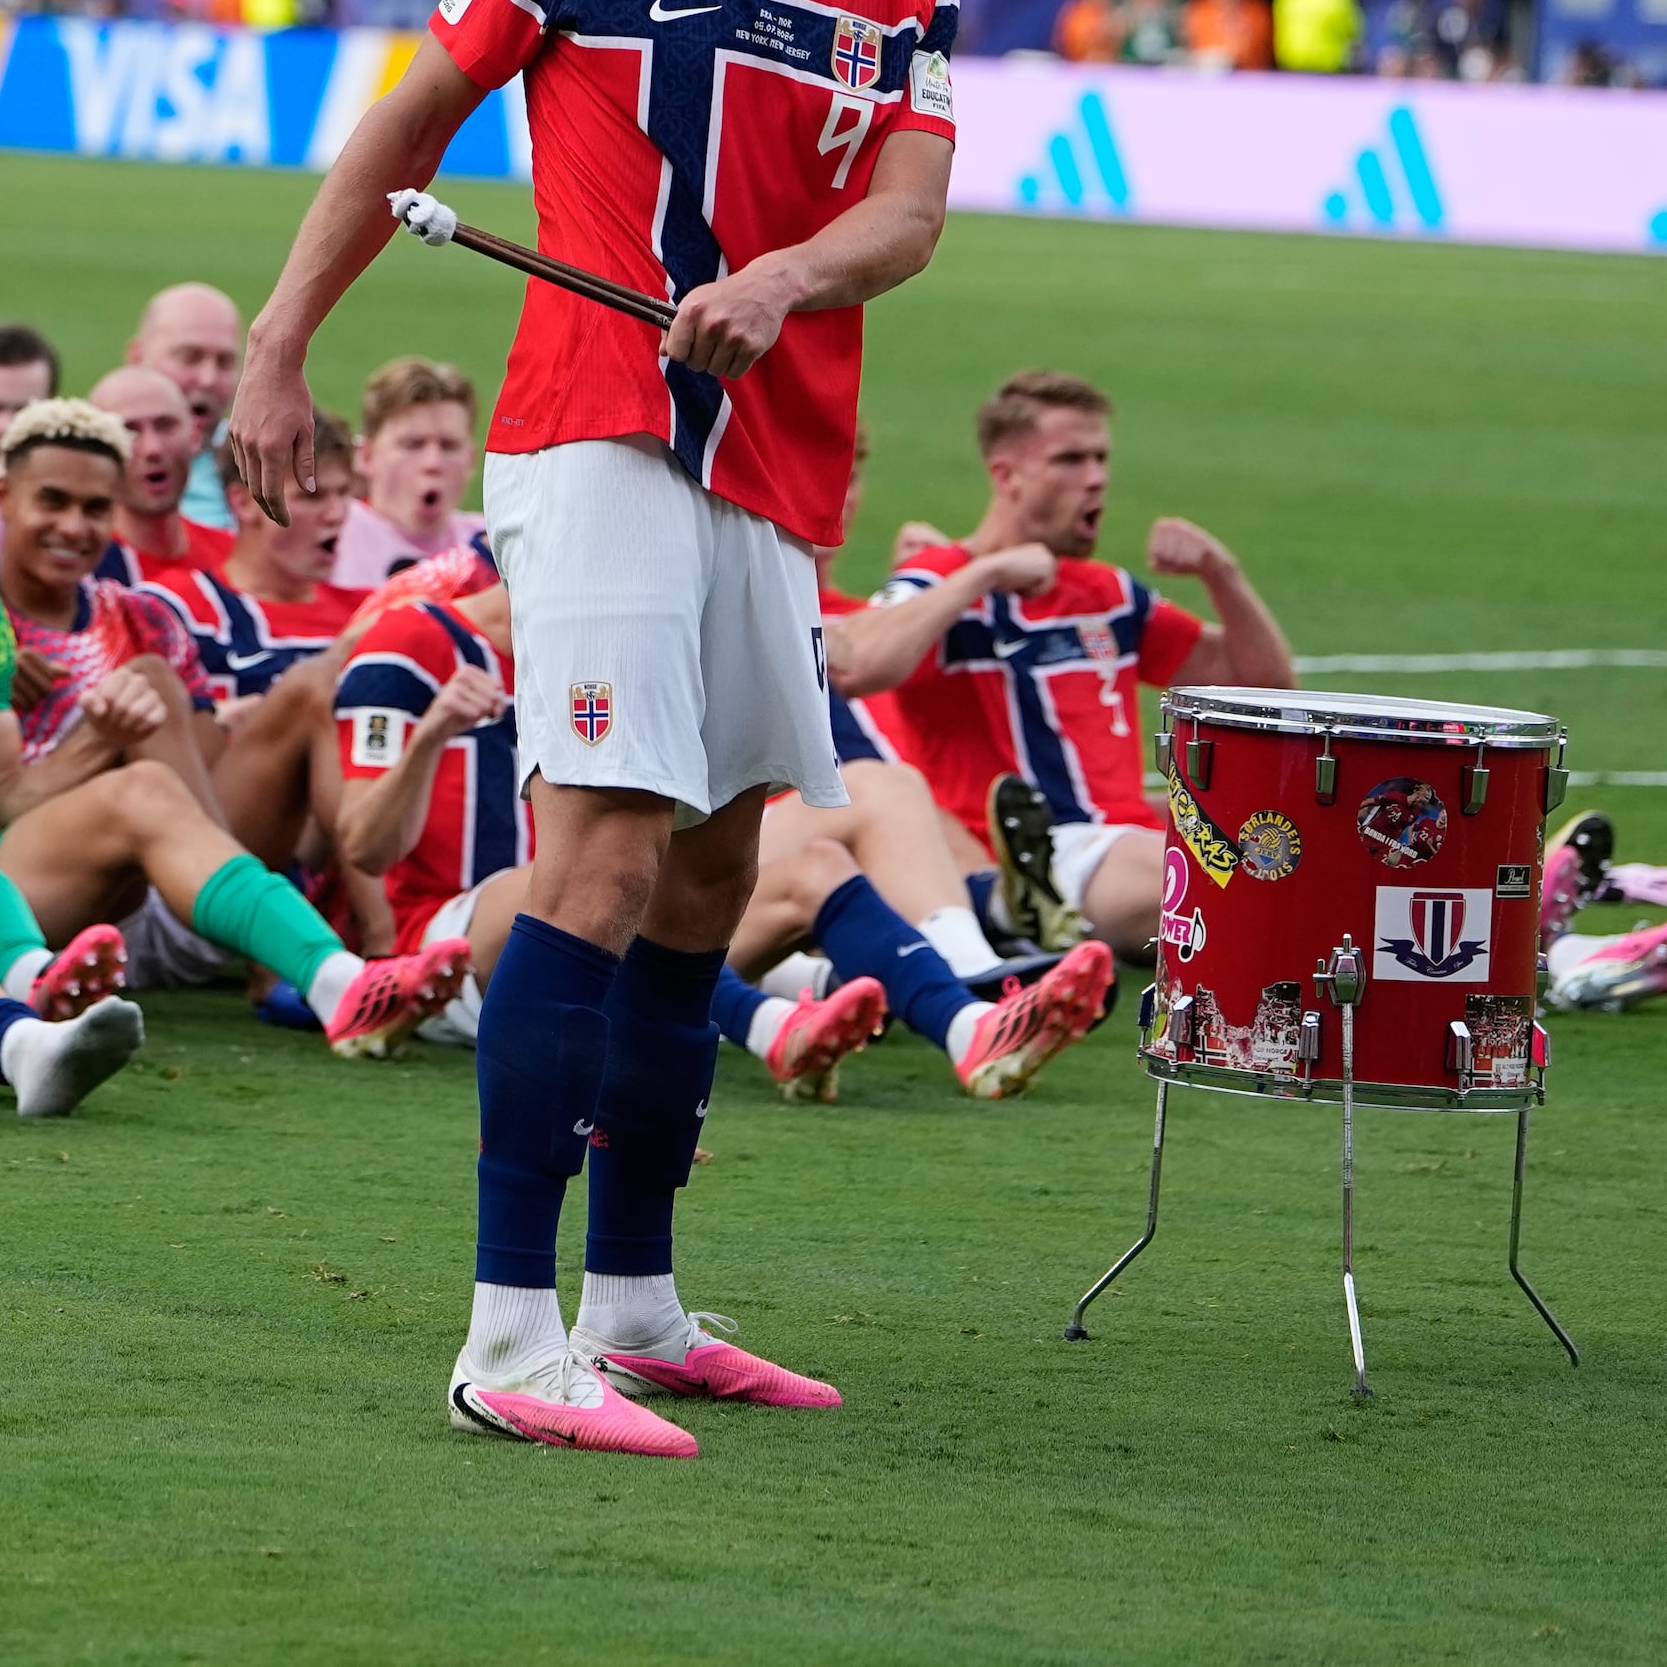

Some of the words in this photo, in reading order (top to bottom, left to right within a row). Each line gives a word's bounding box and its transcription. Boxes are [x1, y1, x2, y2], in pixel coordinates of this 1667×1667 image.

[736, 29, 750, 41] NEW
[751, 33, 769, 47] YORK
[769, 38, 784, 51] NEW
[785, 45, 812, 61] JERSEY
[61, 22, 273, 164] VISA
[817, 91, 875, 189] 9
[1163, 916, 1191, 944] OWER
